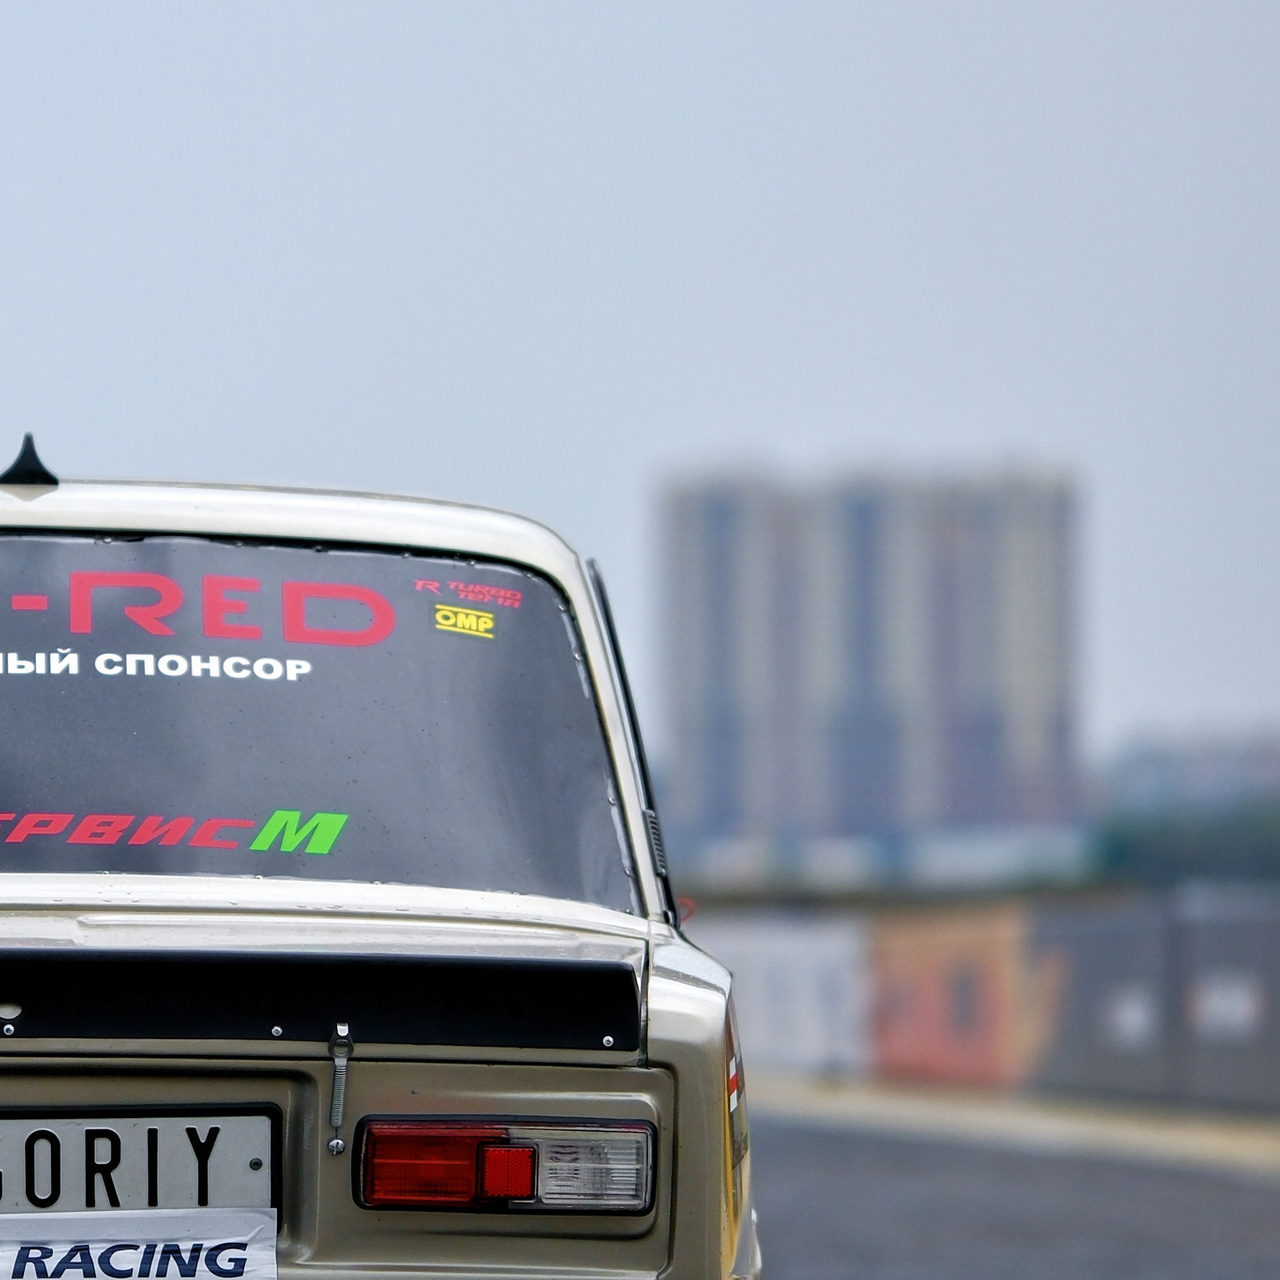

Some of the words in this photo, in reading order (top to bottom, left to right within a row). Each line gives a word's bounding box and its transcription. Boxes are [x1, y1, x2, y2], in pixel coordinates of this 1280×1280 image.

[435, 609, 494, 632] OMP
[94, 653, 312, 681] СПОНСОР
[11, 1241, 249, 1280] RACING
